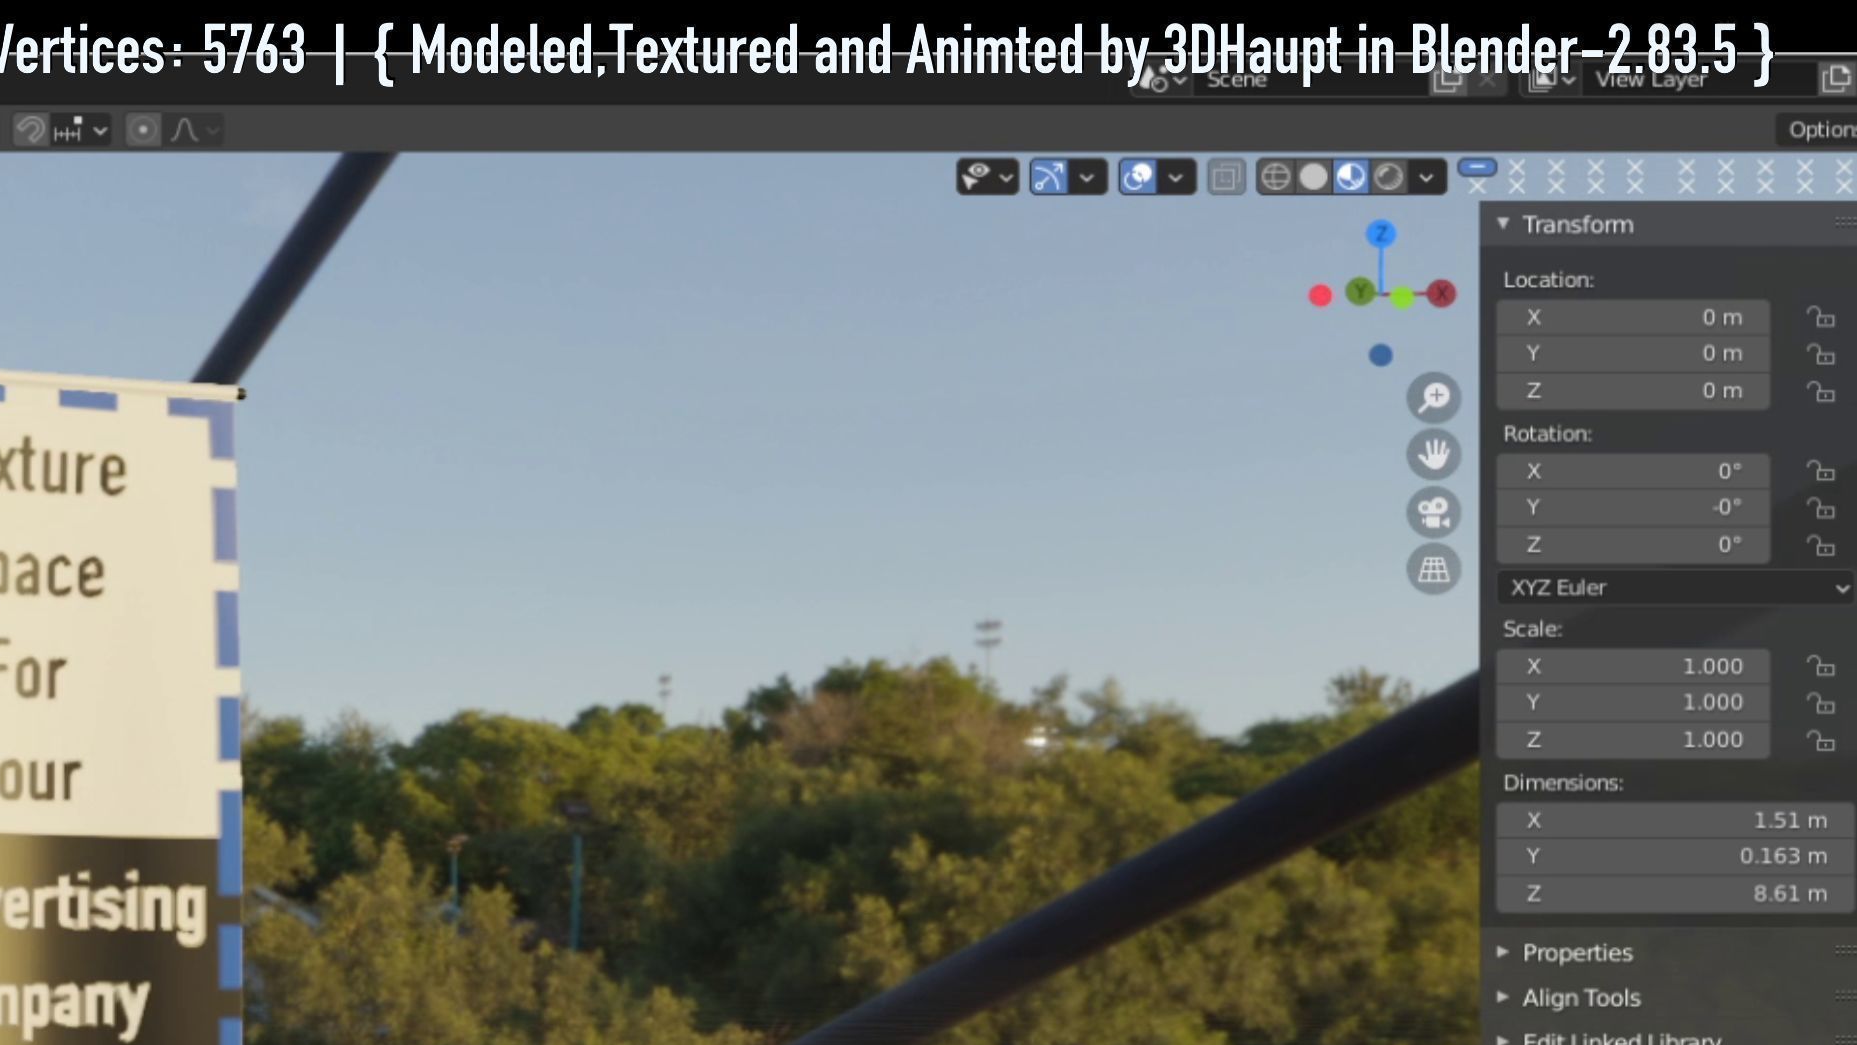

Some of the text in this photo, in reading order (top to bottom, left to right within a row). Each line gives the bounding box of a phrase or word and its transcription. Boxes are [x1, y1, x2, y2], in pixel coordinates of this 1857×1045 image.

[1207, 70, 1268, 88] Scene
[1595, 70, 1708, 92] View Layer
[1522, 215, 1634, 235] Transform
[1503, 272, 1595, 289] Location:
[1526, 309, 1542, 327] X
[1703, 309, 1743, 327] 0 m
[1526, 345, 1542, 363] Y
[1703, 345, 1743, 363] 0 m
[1526, 382, 1542, 400] Z
[1703, 382, 1743, 400] 0 m
[1503, 425, 1593, 443] Rotation:
[1526, 463, 1542, 481] X
[1526, 498, 1542, 516] Y
[1526, 536, 1542, 554] Z
[1511, 578, 1608, 597] XYZ Euler
[1503, 620, 1563, 638] Scale:
[1526, 658, 1542, 676] X
[1683, 658, 1744, 675] 1.000
[1526, 693, 1542, 711] Y
[1683, 693, 1744, 710] 1.000
[1526, 731, 1542, 749] Z
[1683, 731, 1744, 748] 1.000
[1503, 773, 1624, 792] Dimensions:
[1526, 812, 1542, 830] X
[1754, 812, 1828, 829] 1.51 m
[1526, 848, 1542, 866] Y
[1740, 848, 1828, 865] 0.163 m
[1526, 885, 1542, 903] Z
[1753, 885, 1828, 902] 8.61 m
[1523, 943, 1634, 966] Properties
[1523, 988, 1642, 1012] Align Tools
